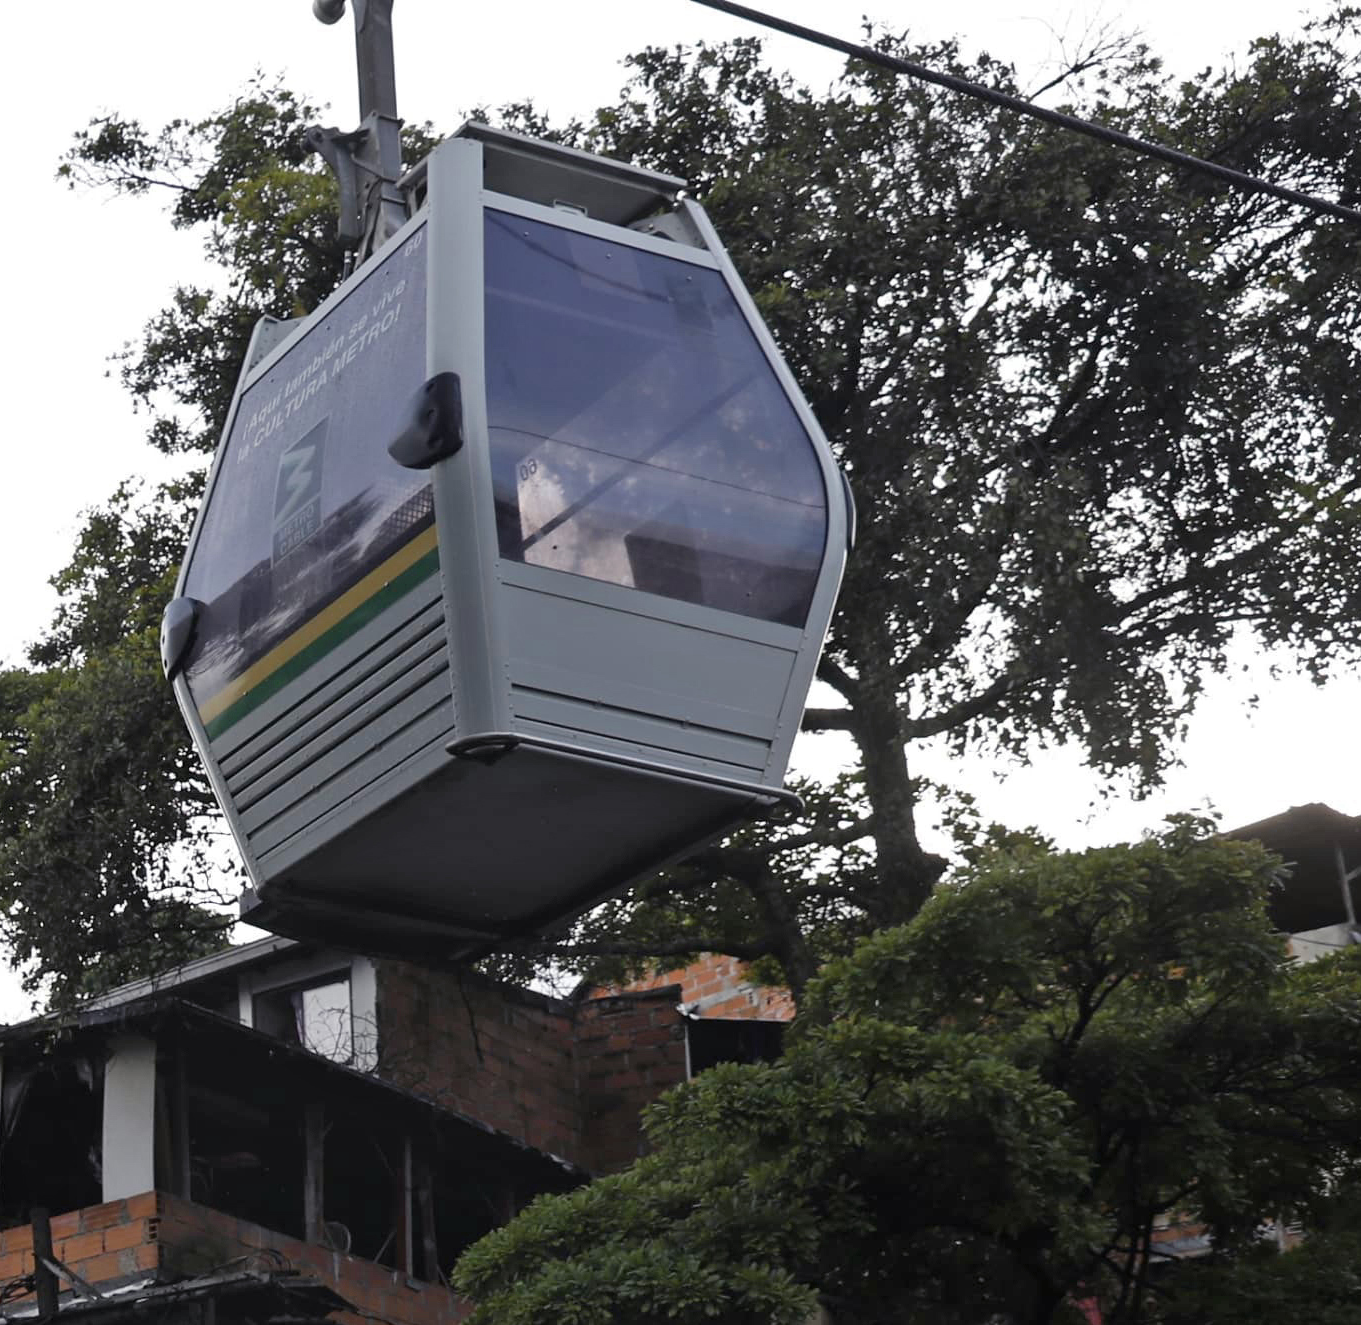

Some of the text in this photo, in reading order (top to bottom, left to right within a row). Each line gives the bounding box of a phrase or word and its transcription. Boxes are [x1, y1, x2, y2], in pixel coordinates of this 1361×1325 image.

[404, 231, 423, 257] 60
[349, 314, 368, 340] se
[372, 279, 406, 317] vive
[254, 369, 327, 447] CULTURA
[331, 303, 401, 377] METRO!
